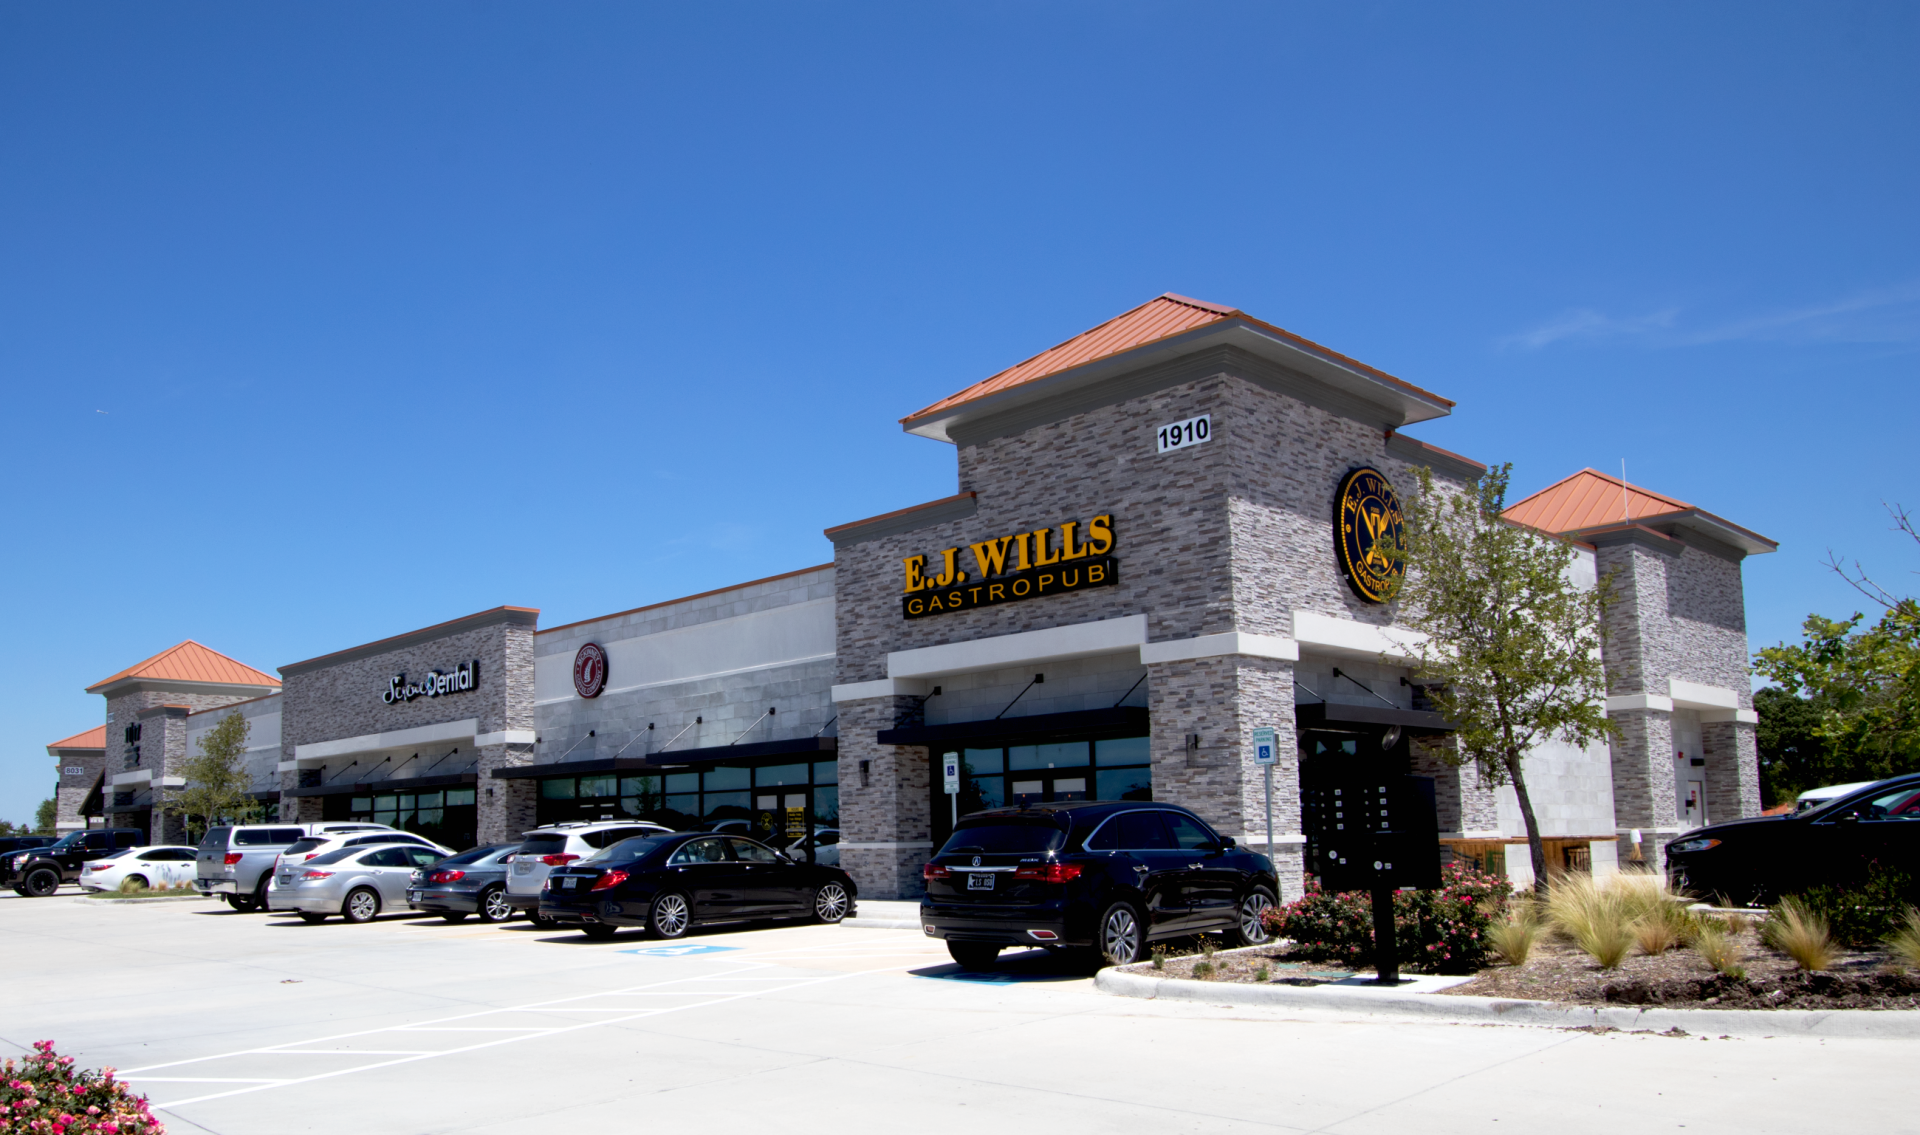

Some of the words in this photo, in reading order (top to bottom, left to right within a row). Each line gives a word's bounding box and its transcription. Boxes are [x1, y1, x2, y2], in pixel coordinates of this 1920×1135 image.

[1158, 418, 1209, 449] 1910
[1346, 482, 1366, 515] E.J.
[1365, 477, 1402, 525] WILLS
[902, 546, 967, 594] E.J.
[969, 513, 1115, 579] WILLS
[907, 563, 1107, 616] GASTROPUB
[1356, 560, 1399, 592] GASTROPB
[427, 662, 473, 696] Dental
